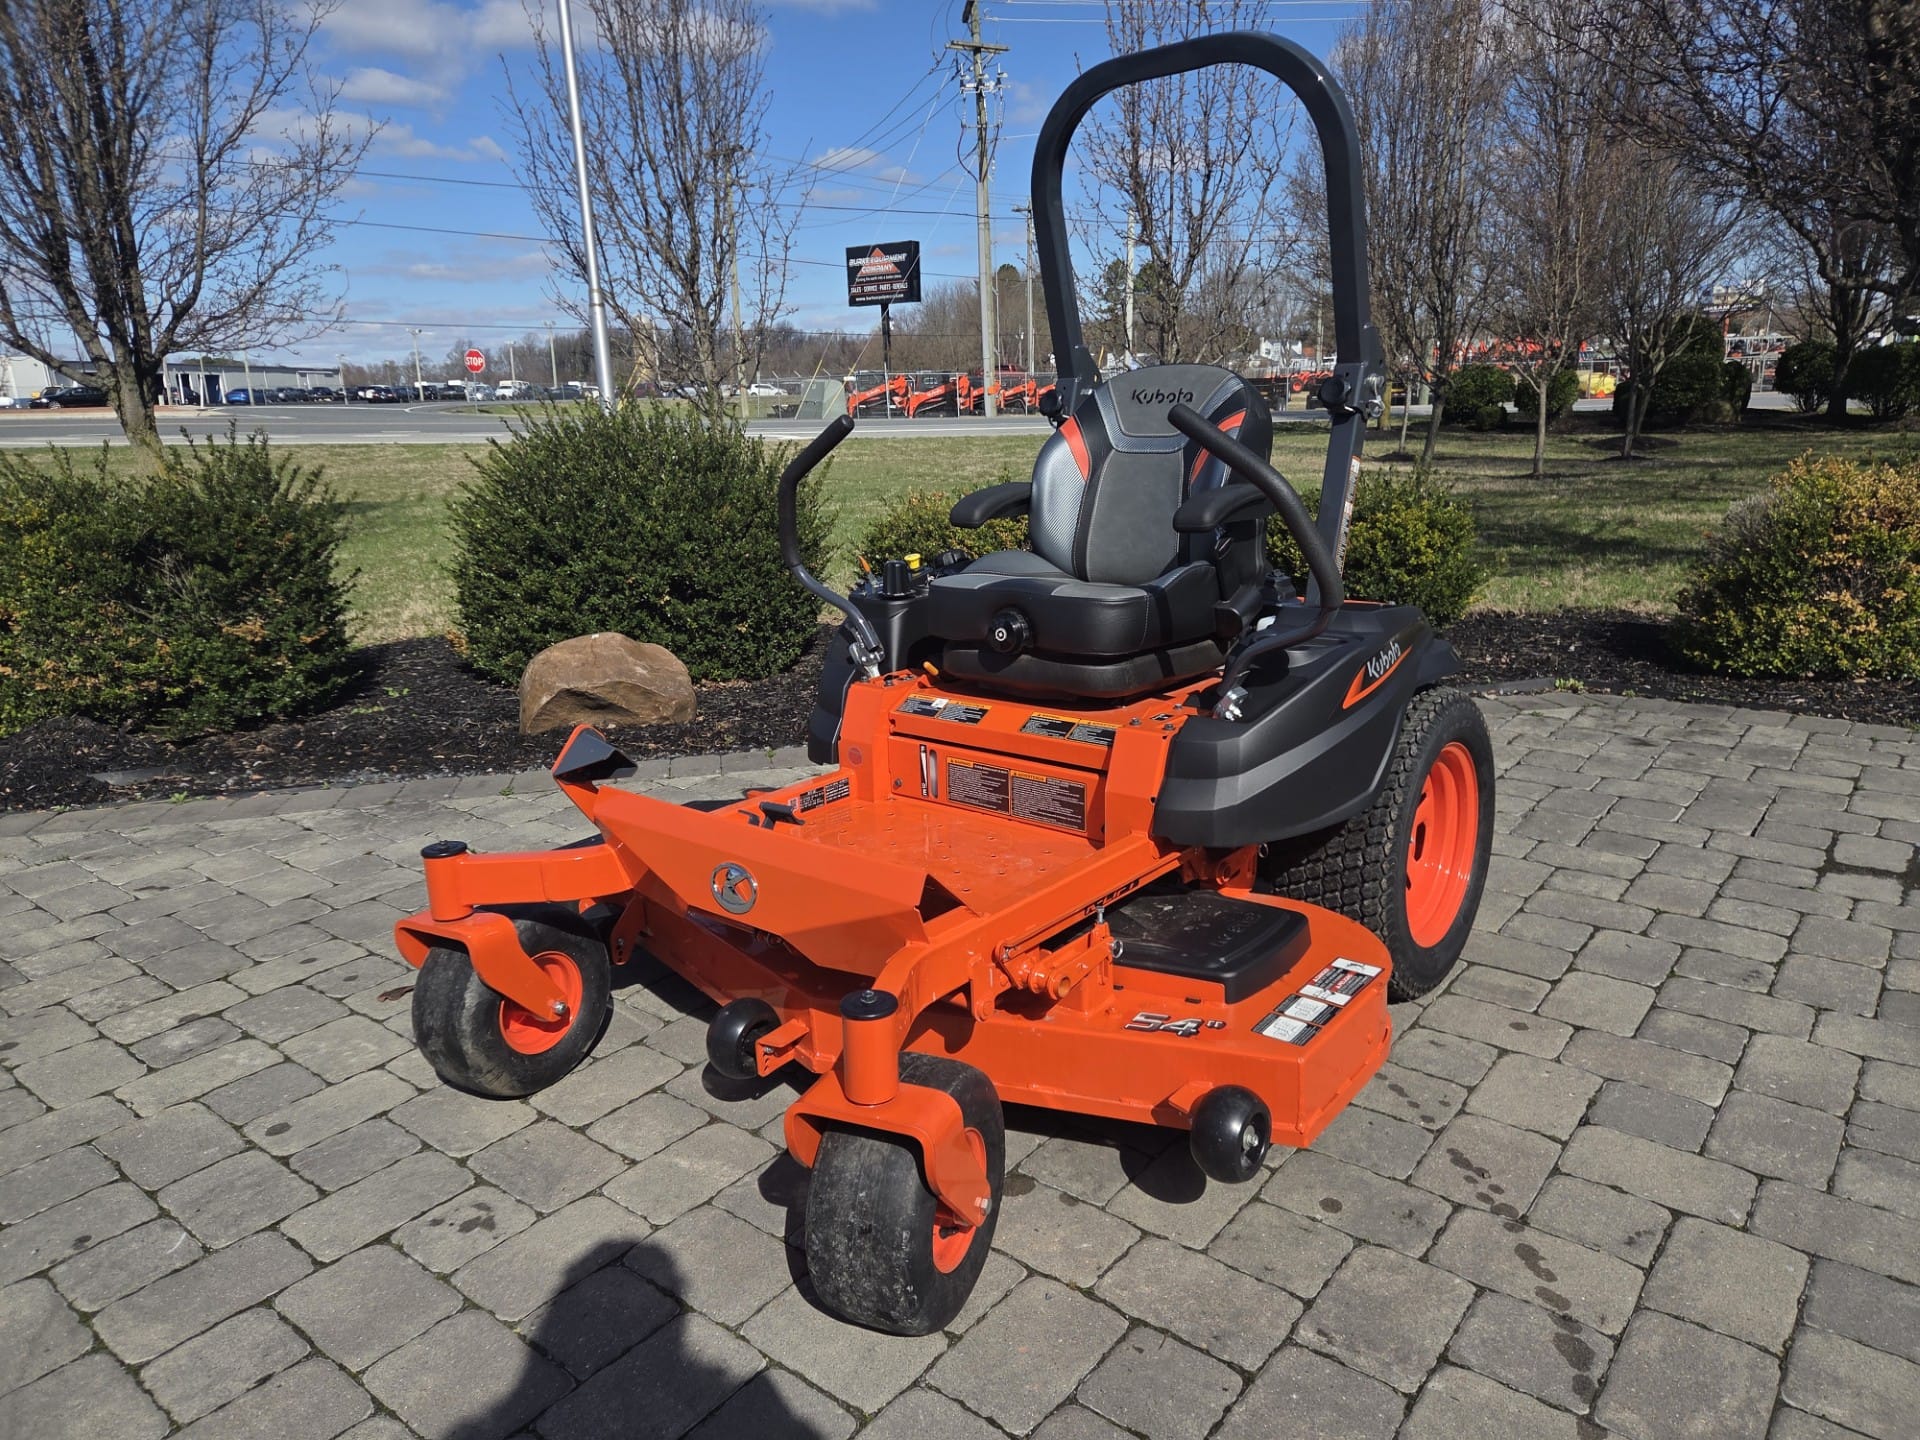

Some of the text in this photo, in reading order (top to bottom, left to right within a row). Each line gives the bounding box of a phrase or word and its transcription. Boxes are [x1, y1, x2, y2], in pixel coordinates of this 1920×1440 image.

[849, 253, 906, 267] BURKE EQUIPMENT
[861, 264, 893, 273] COMPANY
[465, 357, 483, 366] STOP
[1131, 387, 1194, 405] Kubota
[1367, 640, 1402, 678] Kubota
